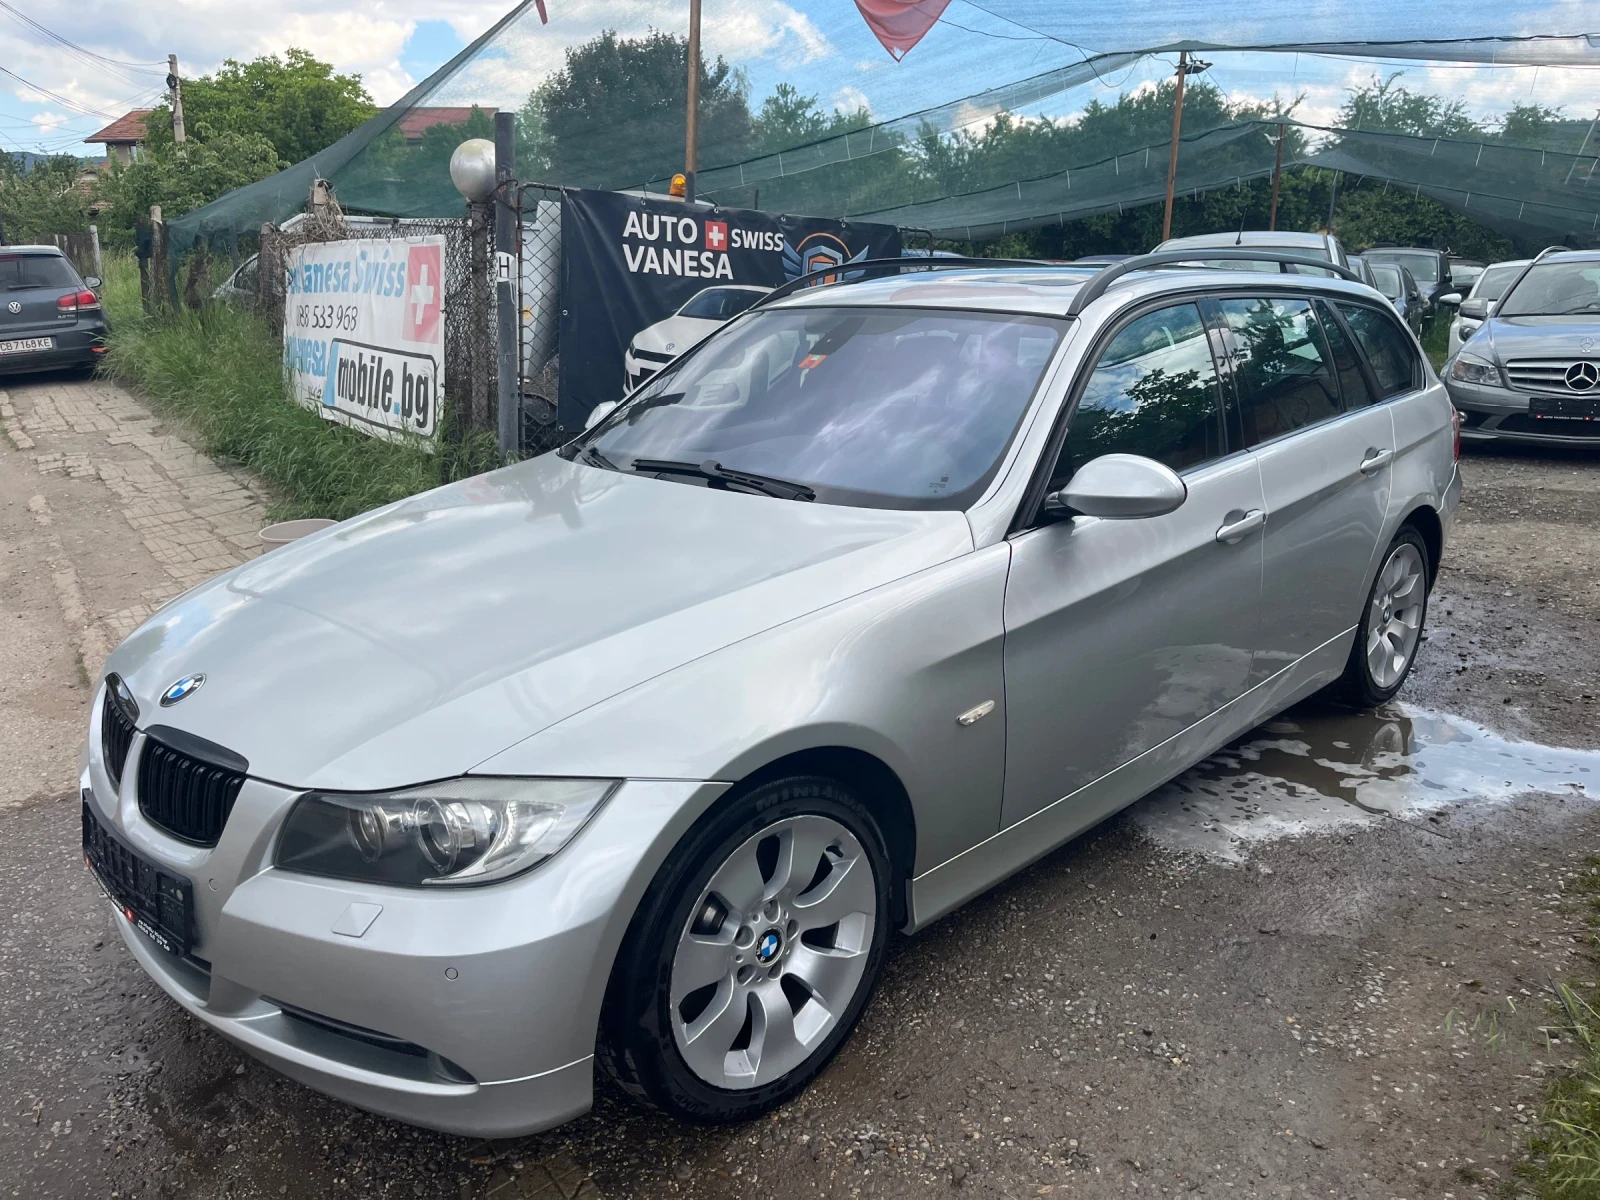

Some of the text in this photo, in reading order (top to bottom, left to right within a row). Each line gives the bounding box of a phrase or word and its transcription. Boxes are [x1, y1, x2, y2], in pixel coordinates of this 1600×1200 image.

[622, 211, 784, 252] AUTO SWISS
[352, 249, 406, 298] Swiss
[622, 243, 734, 280] VANESA
[37, 338, 51, 348] KE
[337, 352, 429, 429] mobile.bg
